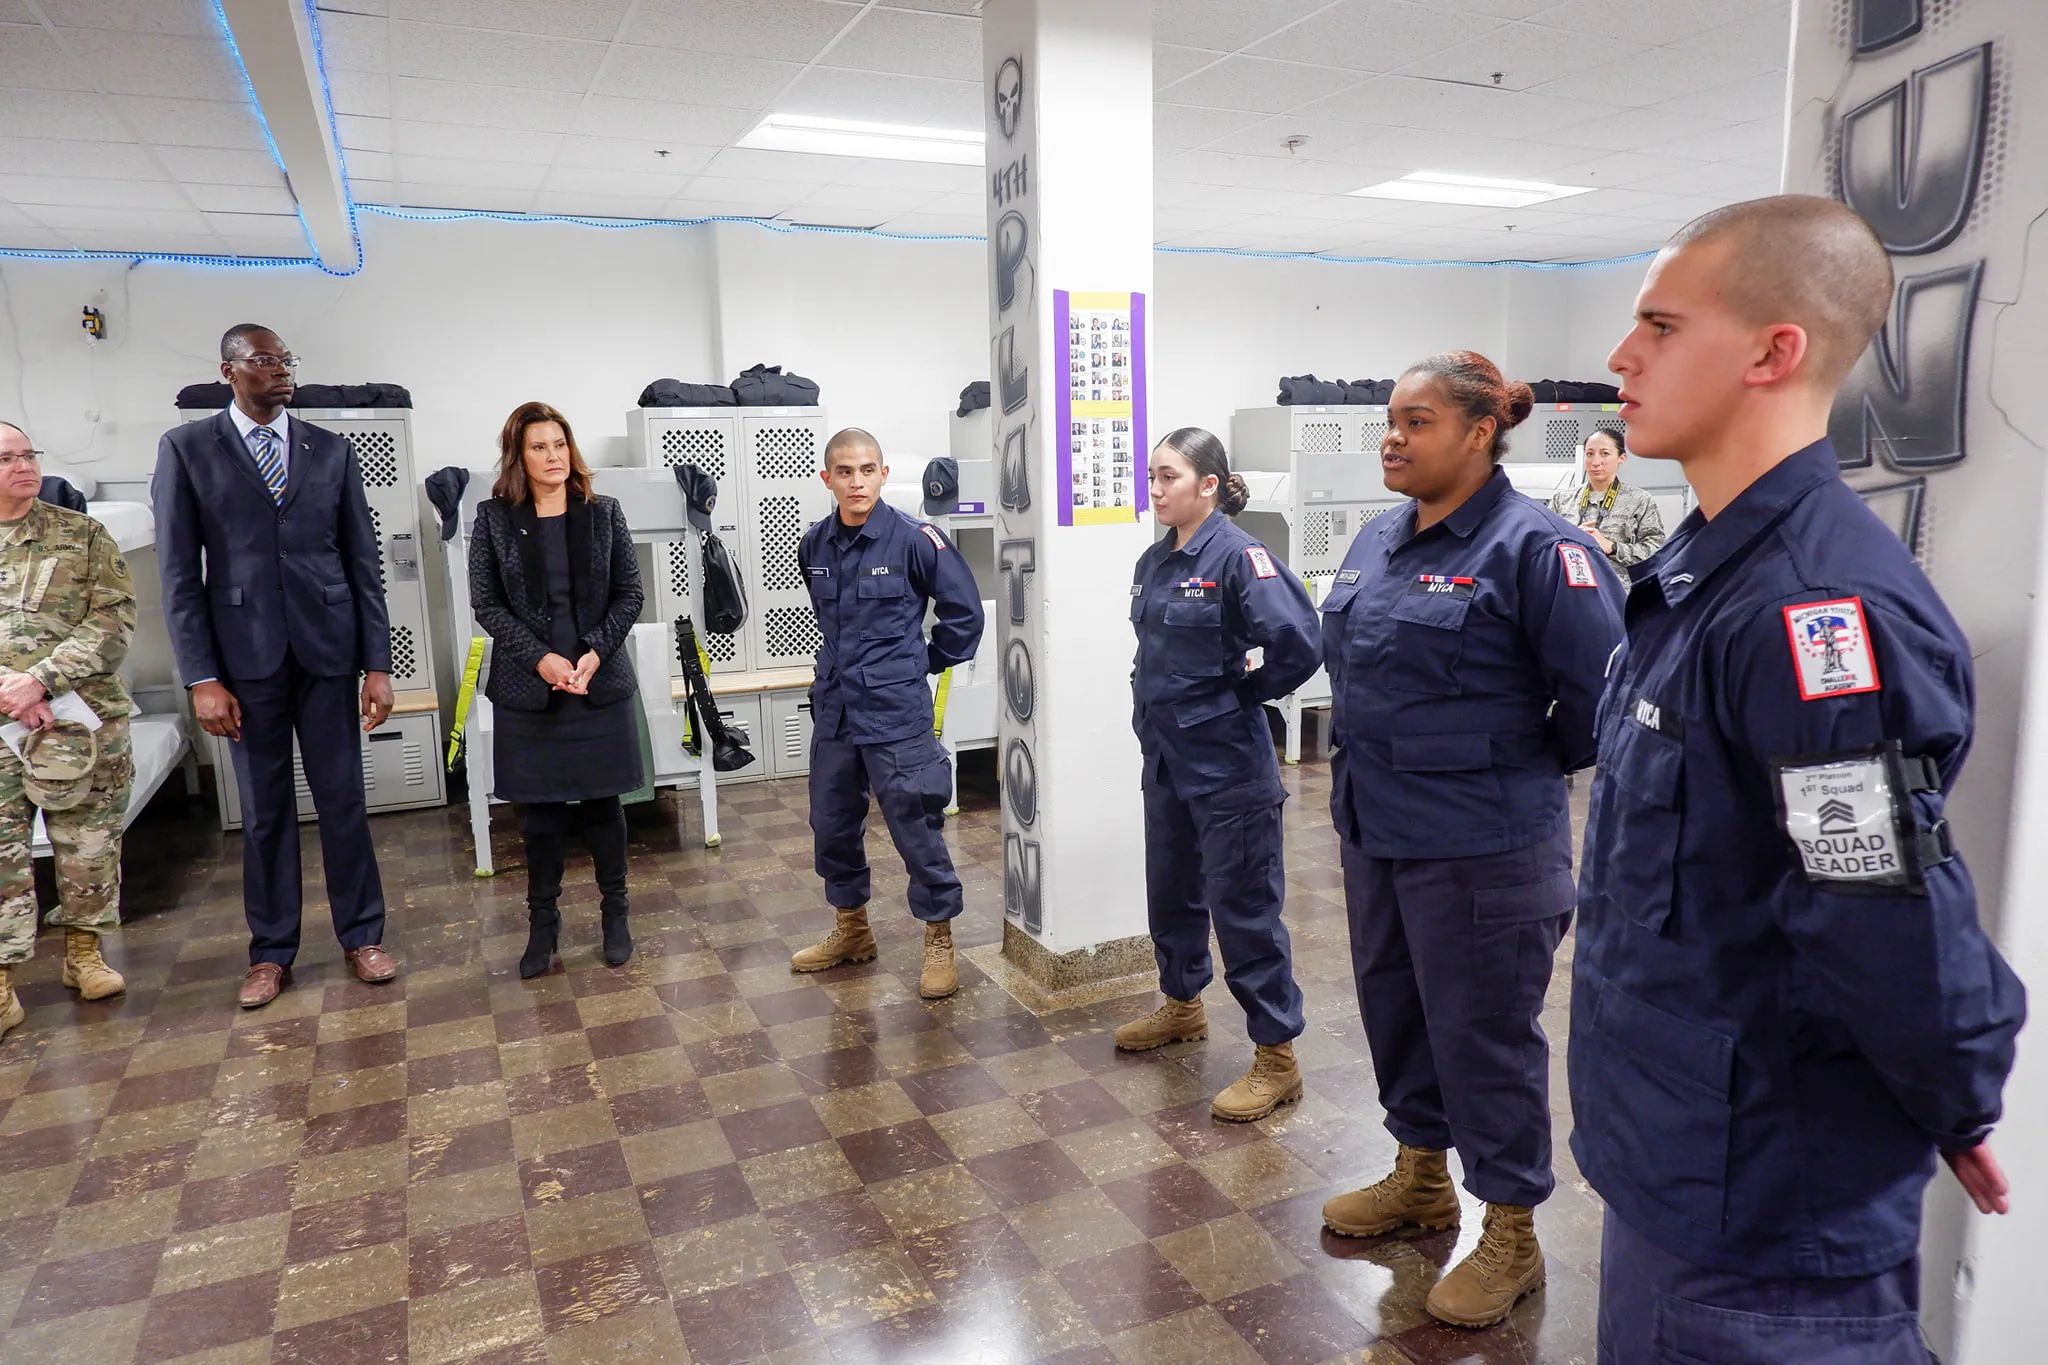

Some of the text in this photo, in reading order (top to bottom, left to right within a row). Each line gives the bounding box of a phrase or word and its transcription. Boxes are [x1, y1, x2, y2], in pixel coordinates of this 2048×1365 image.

[993, 153, 1028, 209] 4TH
[55, 543, 76, 552] ARMY
[871, 566, 889, 576] MYCA
[996, 210, 1042, 935] PLATOON
[1184, 588, 1205, 598] MYCA
[1427, 582, 1454, 593] MYCA
[1821, 782, 1864, 796] Squad
[1801, 834, 1886, 856] SQUAD
[1804, 852, 1896, 874] LEADER
